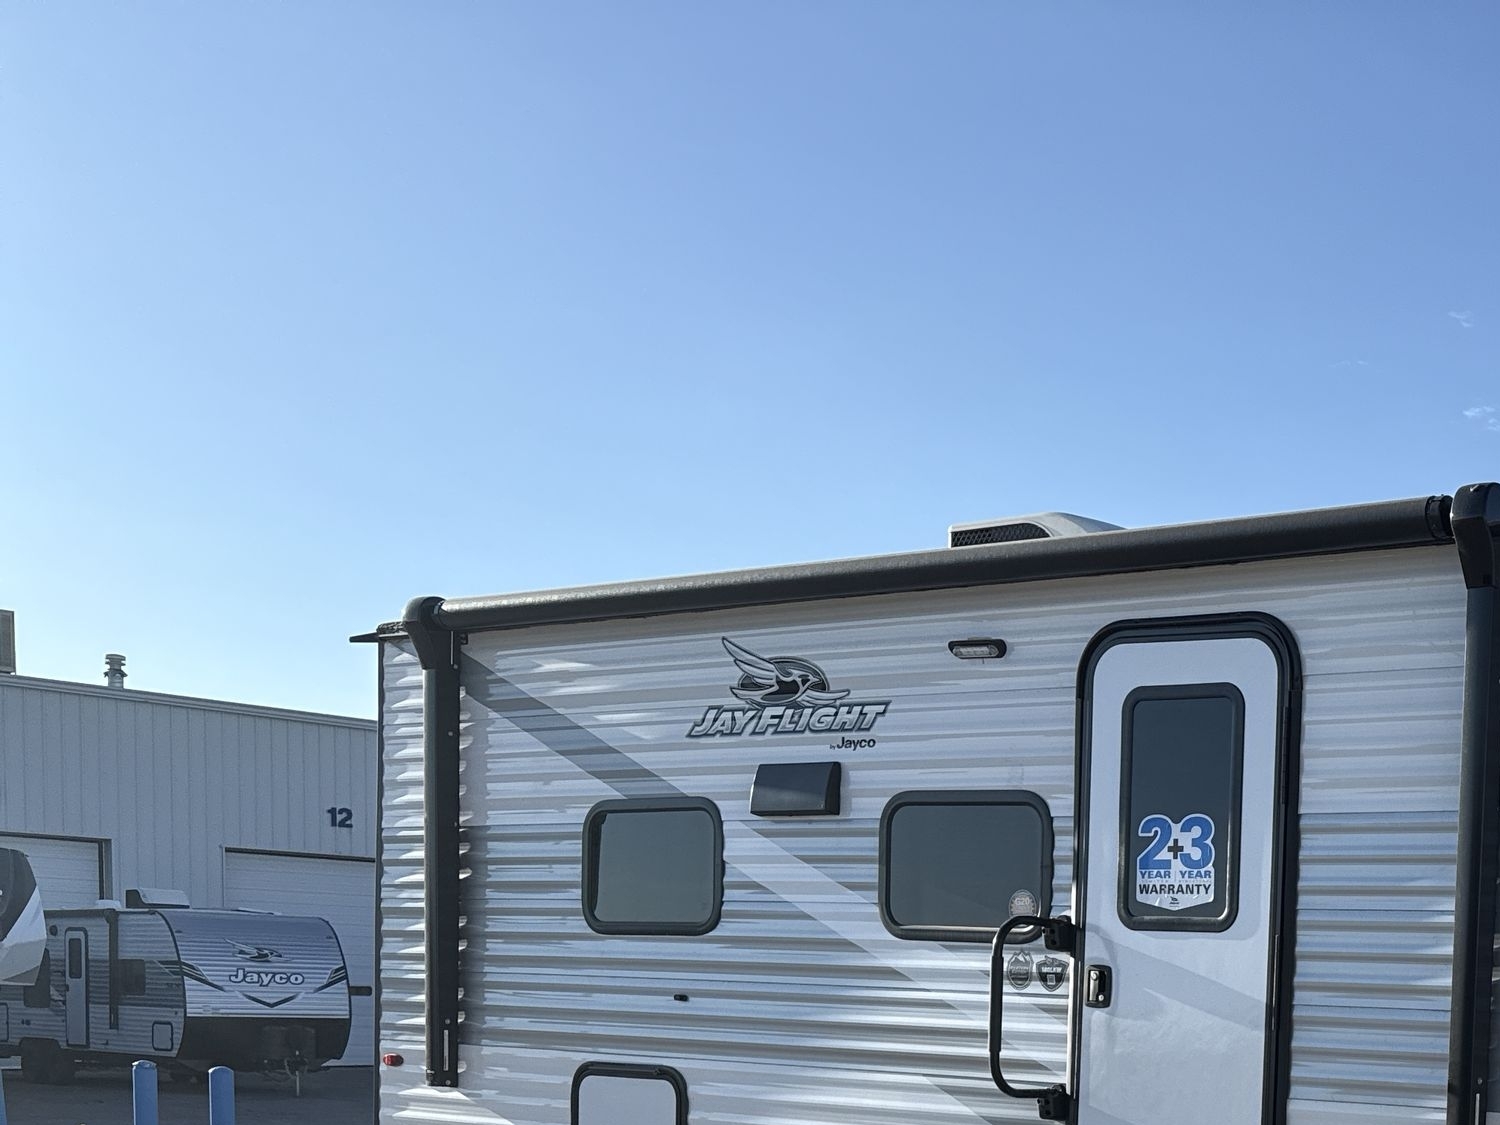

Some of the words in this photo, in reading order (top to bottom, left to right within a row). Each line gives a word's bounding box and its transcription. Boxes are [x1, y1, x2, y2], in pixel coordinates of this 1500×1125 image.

[836, 736, 876, 751] Jayco
[326, 807, 353, 828] 12
[1140, 870, 1171, 879] YEAR
[1179, 870, 1212, 879] YEAR
[1139, 883, 1212, 895] WARRANTY
[229, 968, 304, 987] Jayco
